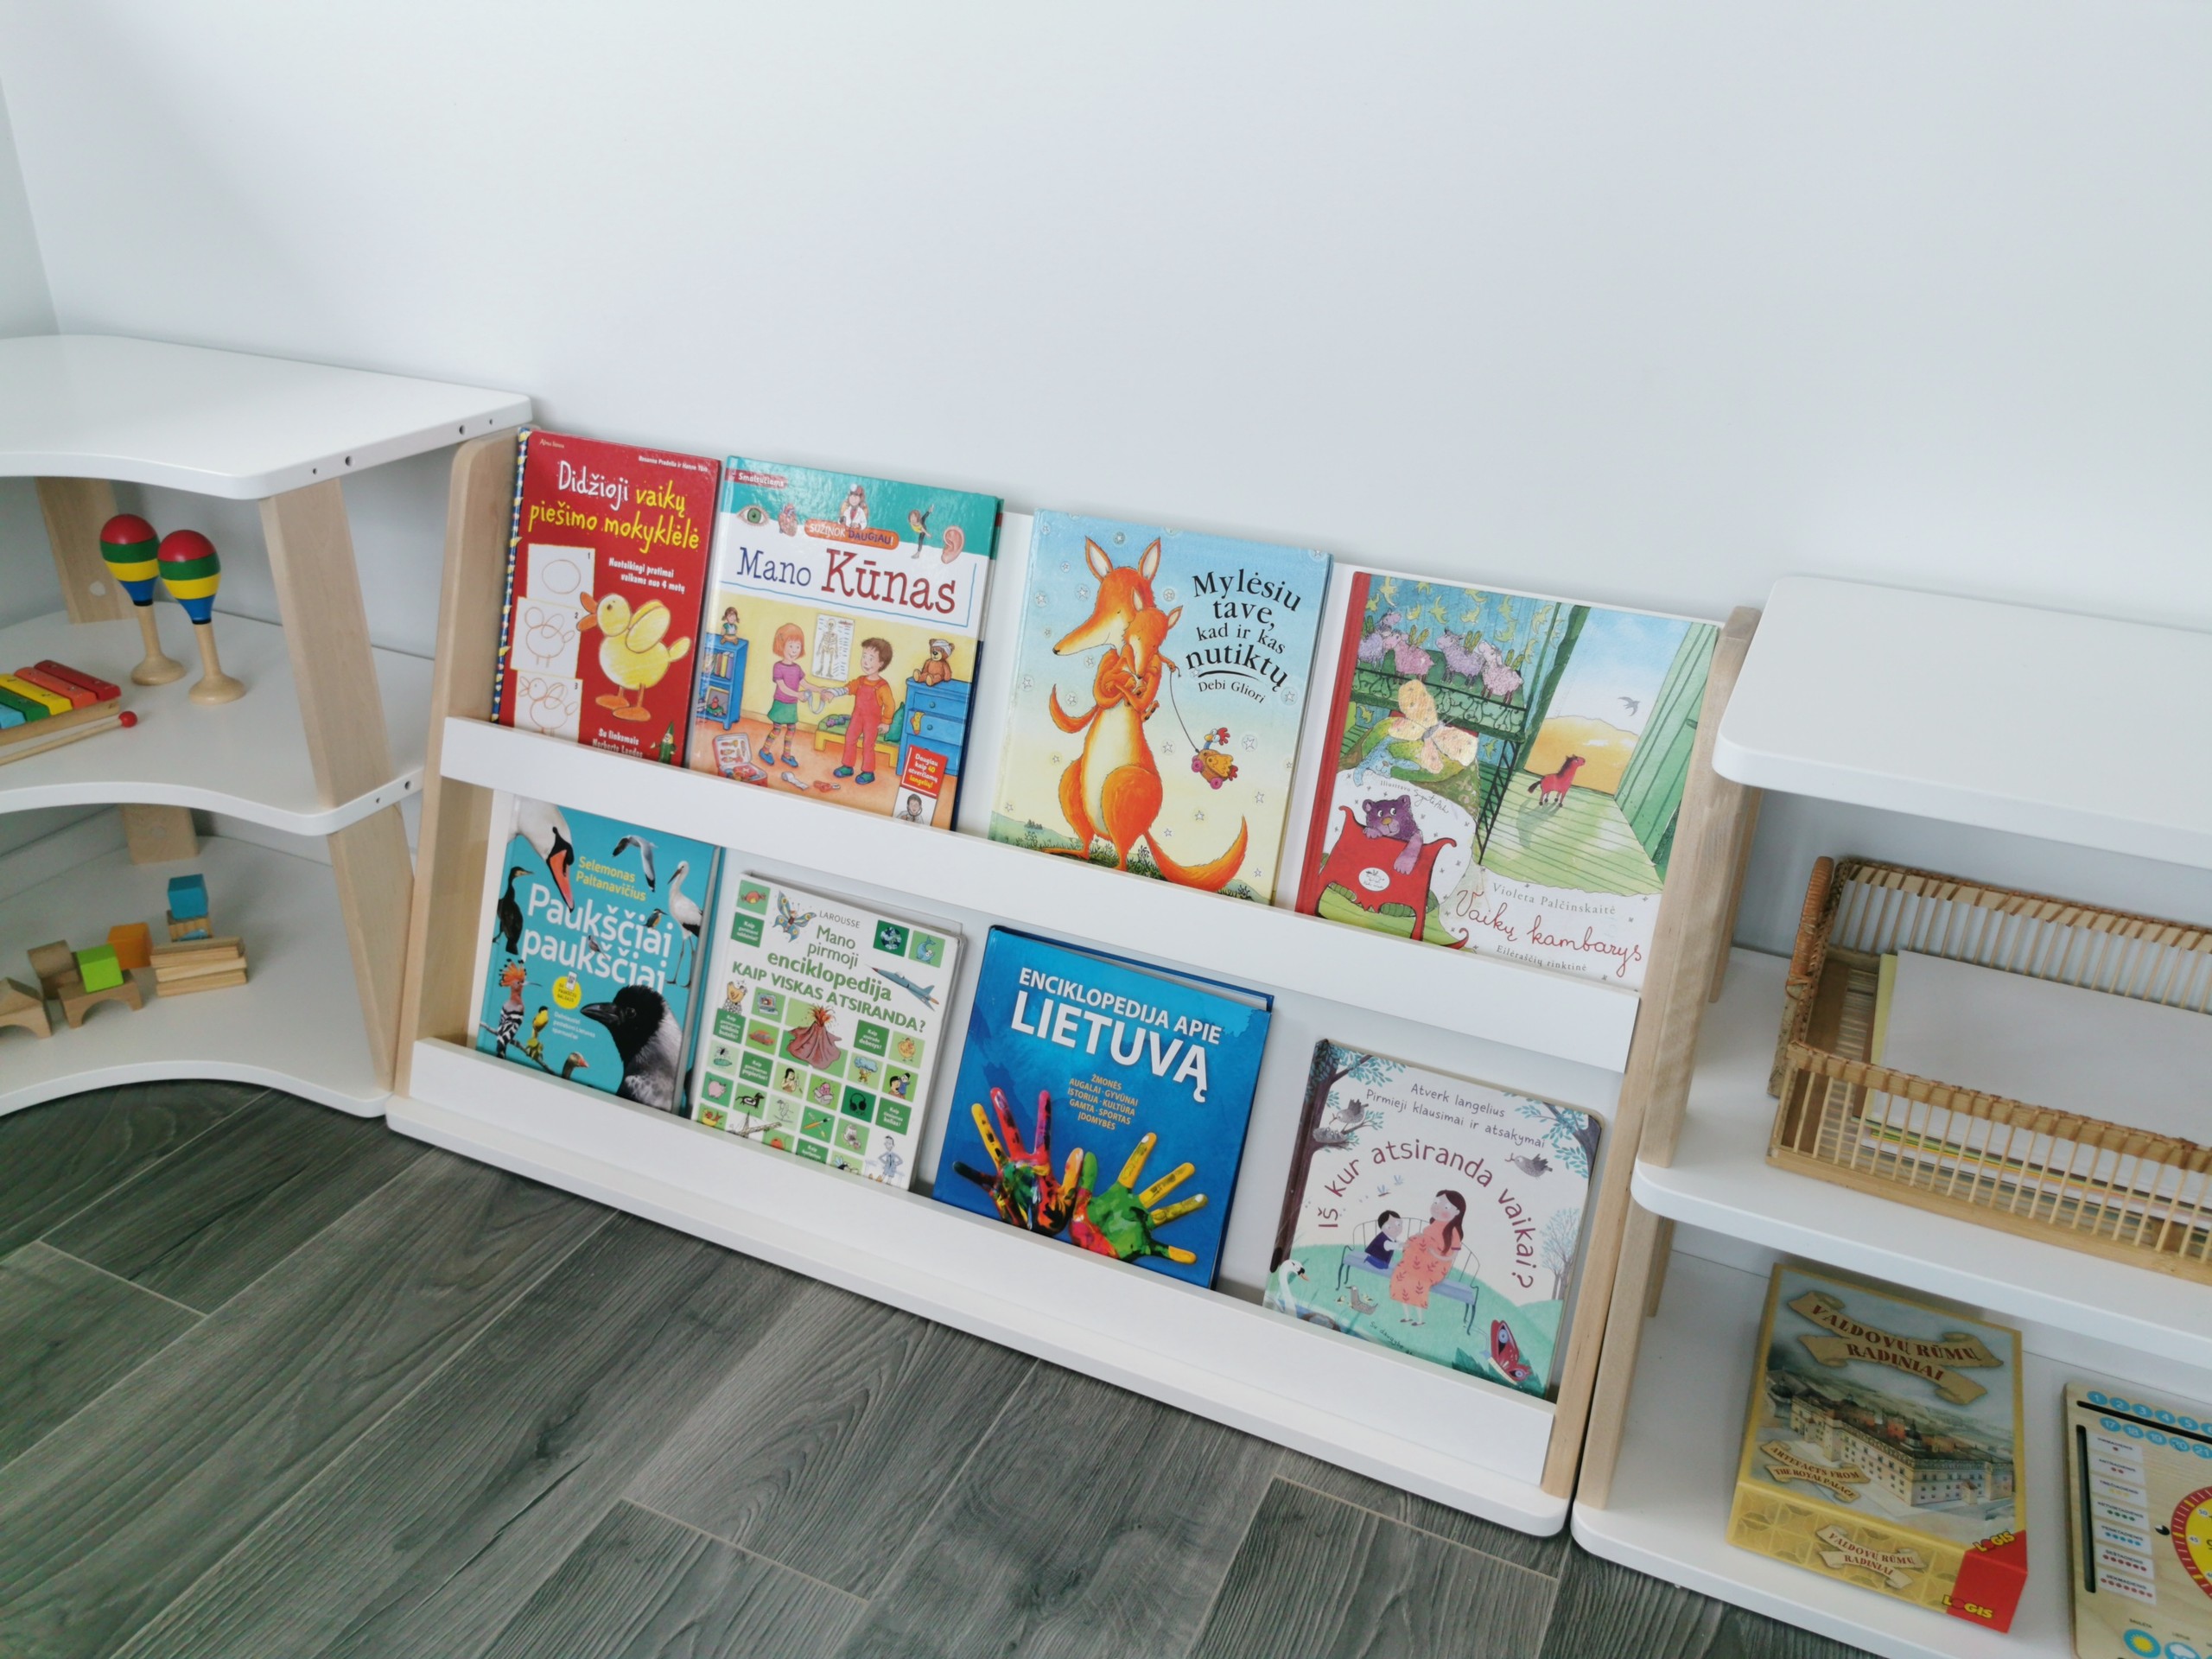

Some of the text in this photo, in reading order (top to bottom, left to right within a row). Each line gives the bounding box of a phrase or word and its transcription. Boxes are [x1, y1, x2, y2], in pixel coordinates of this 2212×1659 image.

[558, 460, 685, 518] Didžioji vaikų
[528, 500, 699, 554] piešimo mokyklėlė
[608, 556, 675, 578] Nuotaikingi pratimai
[736, 546, 957, 615] Mano Kūnas
[620, 573, 685, 594] vaikams nuo 4 metų
[1192, 569, 1301, 612] Mylėsiu
[1213, 601, 1274, 631] tave,
[1197, 622, 1286, 654] kad ir kas
[1185, 644, 1287, 692] nutiktų
[1198, 679, 1266, 703] Debi Gliori
[598, 728, 607, 738] Su
[915, 753, 938, 767] Daugiau
[915, 760, 927, 772] kaip
[578, 856, 636, 883] Selemonas
[575, 870, 646, 902] Paltanavičius
[1492, 882, 1616, 915] Violeta Palčinskaitė
[527, 883, 674, 958] Paukščiai
[820, 911, 861, 929] LAROUSSE
[1456, 889, 1642, 977] Vaikų kambarys
[817, 925, 855, 950] Mano
[520, 928, 669, 994] paukščiai
[807, 942, 859, 969] pirmoji
[1496, 944, 1587, 972] Eilėraščių rinktinė
[767, 952, 892, 1002] enciklopedija
[732, 961, 926, 1033] KAIP VISKAS ATSIRANDA?
[1019, 967, 1222, 1045] ENCIKLOPEDIJA APIE
[1011, 990, 1208, 1103] LIETUVĄ
[1069, 1078, 1138, 1106] AUGALAI GYVŪNAI
[1091, 1073, 1122, 1090] ŽMONĖS
[1067, 1087, 1135, 1116] ISTORIJA KULTŪRA
[1069, 1098, 1131, 1125] GAMTA SPORTAS
[1410, 1083, 1505, 1118] Atverk langelius
[1366, 1089, 1546, 1148] Pirmieji klausimai ir atsakymai
[1317, 1139, 1537, 1290] Iš kur atsiranda vaikai?
[1811, 1304, 1982, 1361] VALDOVŲ RŪMŲ
[1846, 1343, 1944, 1381] RADINIAI
[2162, 1413, 2170, 1421] 4
[2105, 1420, 2116, 1428] 17
[2195, 1445, 2209, 1458] 21
[1770, 1447, 1859, 1479] ARTEFACTS FROM
[1793, 1469, 1822, 1481] ROYAL
[1823, 1478, 1855, 1498] PALACE
[1828, 1532, 1916, 1566] VALDOVŲ RŪMŲ
[1973, 1530, 2016, 1553] LOGIS
[1844, 1554, 1894, 1576] RADINIAI
[1942, 1594, 1993, 1619] LOGIS
